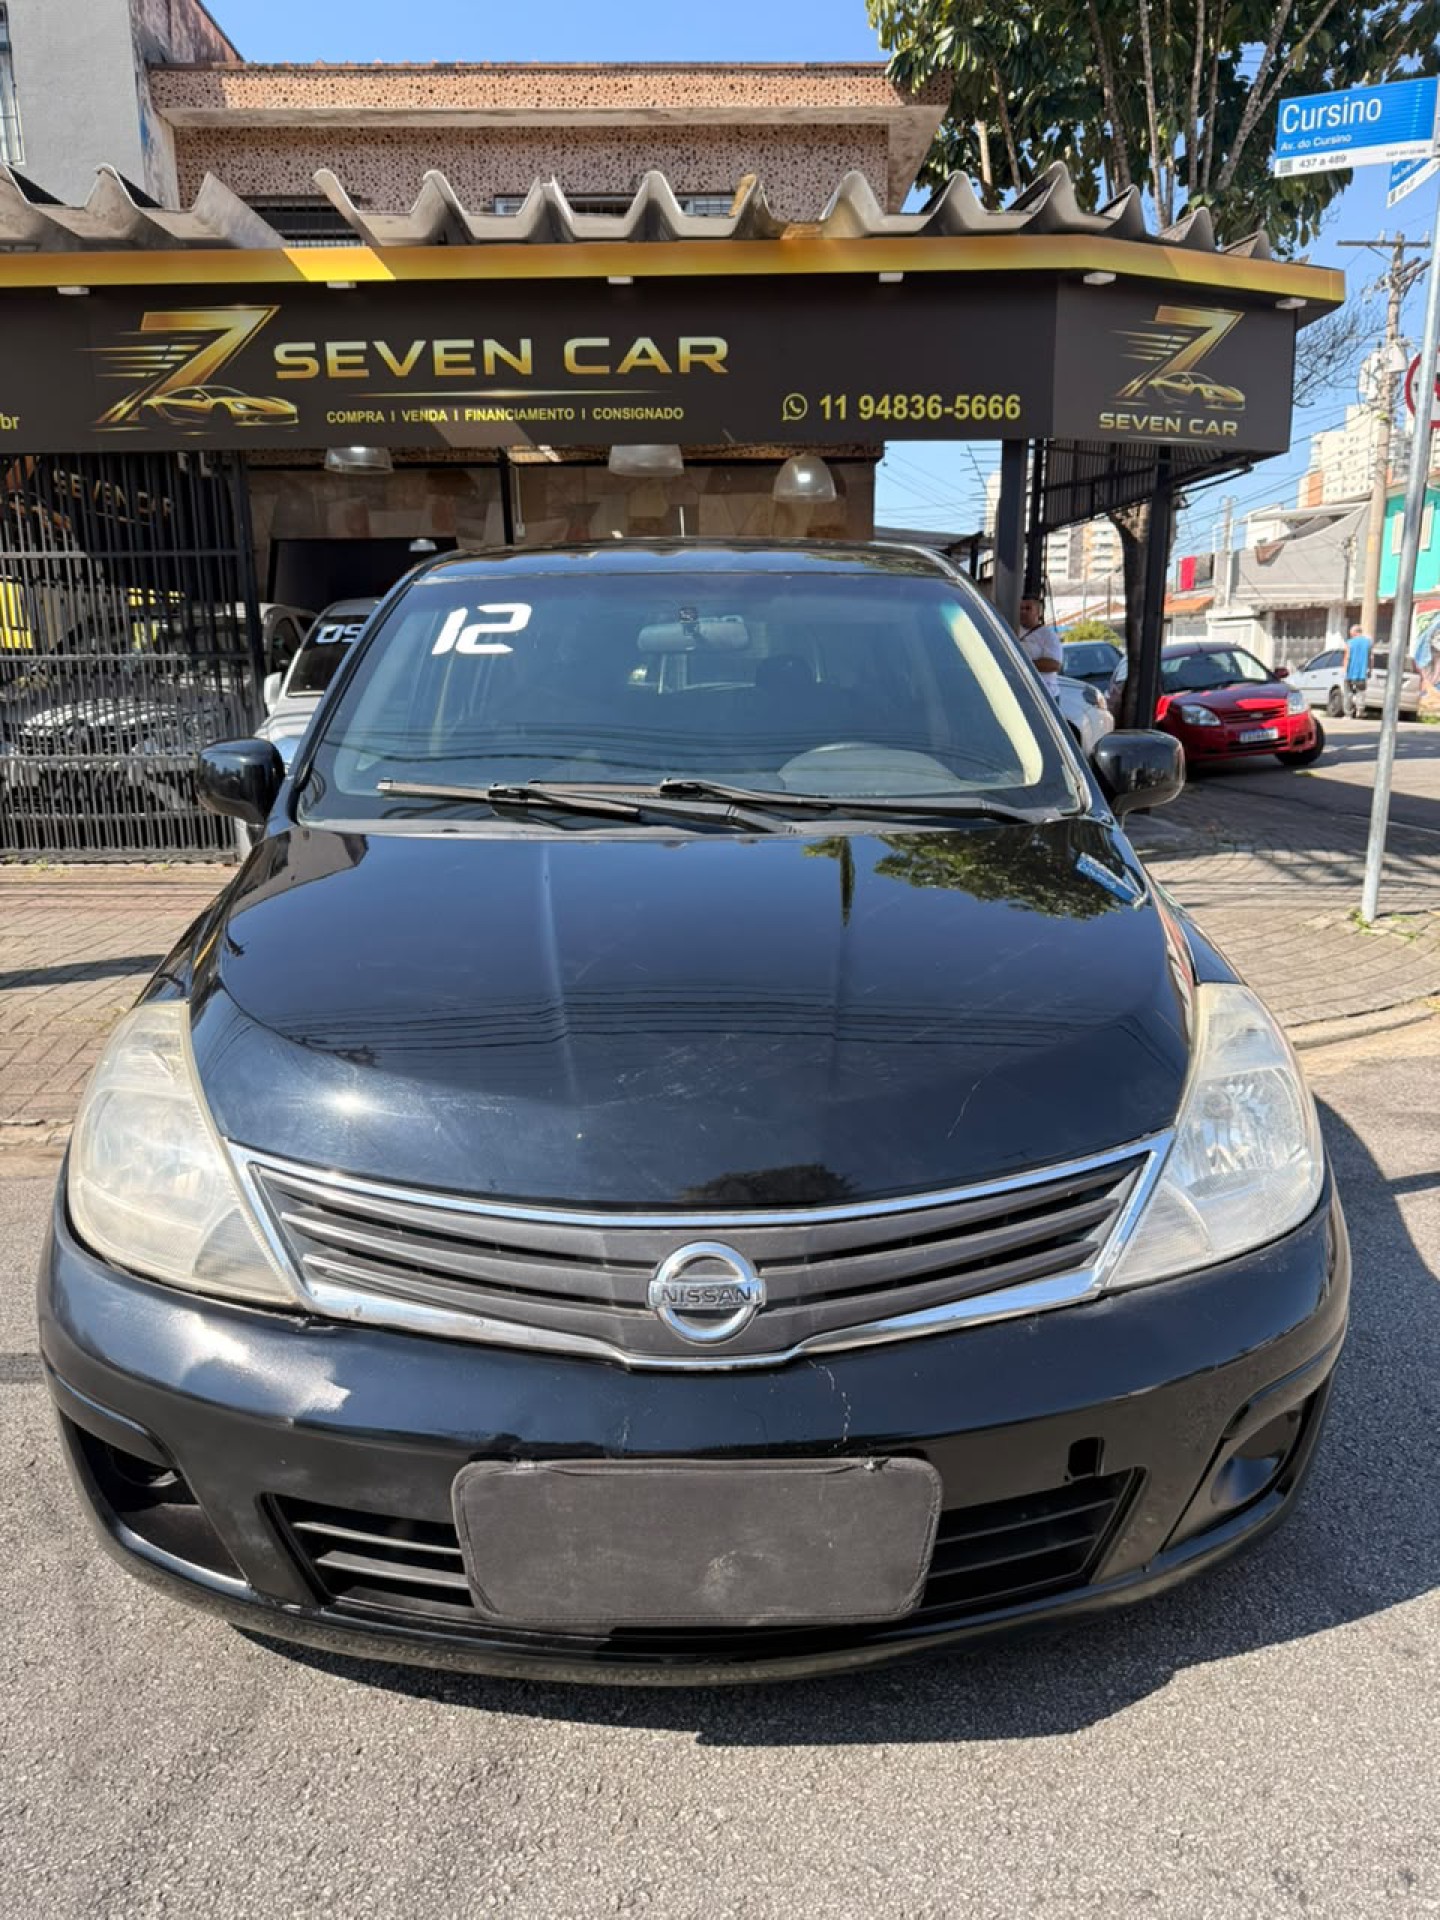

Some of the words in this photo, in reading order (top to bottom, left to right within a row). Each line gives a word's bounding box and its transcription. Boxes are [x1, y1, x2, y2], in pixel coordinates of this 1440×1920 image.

[1282, 96, 1382, 134] Cursino
[1280, 141, 1296, 151] Av.
[1298, 137, 1311, 149] do
[1314, 133, 1353, 146] Cursino
[1319, 158, 1326, 167] a
[273, 338, 533, 379] SEVEN
[563, 336, 729, 375] CAR
[326, 410, 385, 424] COMPRA
[401, 408, 448, 423] VENDA
[464, 407, 576, 422] FINANCIAMENTO
[591, 407, 685, 421] CONSIGNADO
[819, 394, 847, 421] 11
[858, 394, 1022, 421] 94836-5666
[1099, 411, 1181, 433] SEVEN
[1188, 418, 1239, 437] CAR
[432, 602, 532, 655] 12
[661, 1286, 752, 1303] NISSAN
